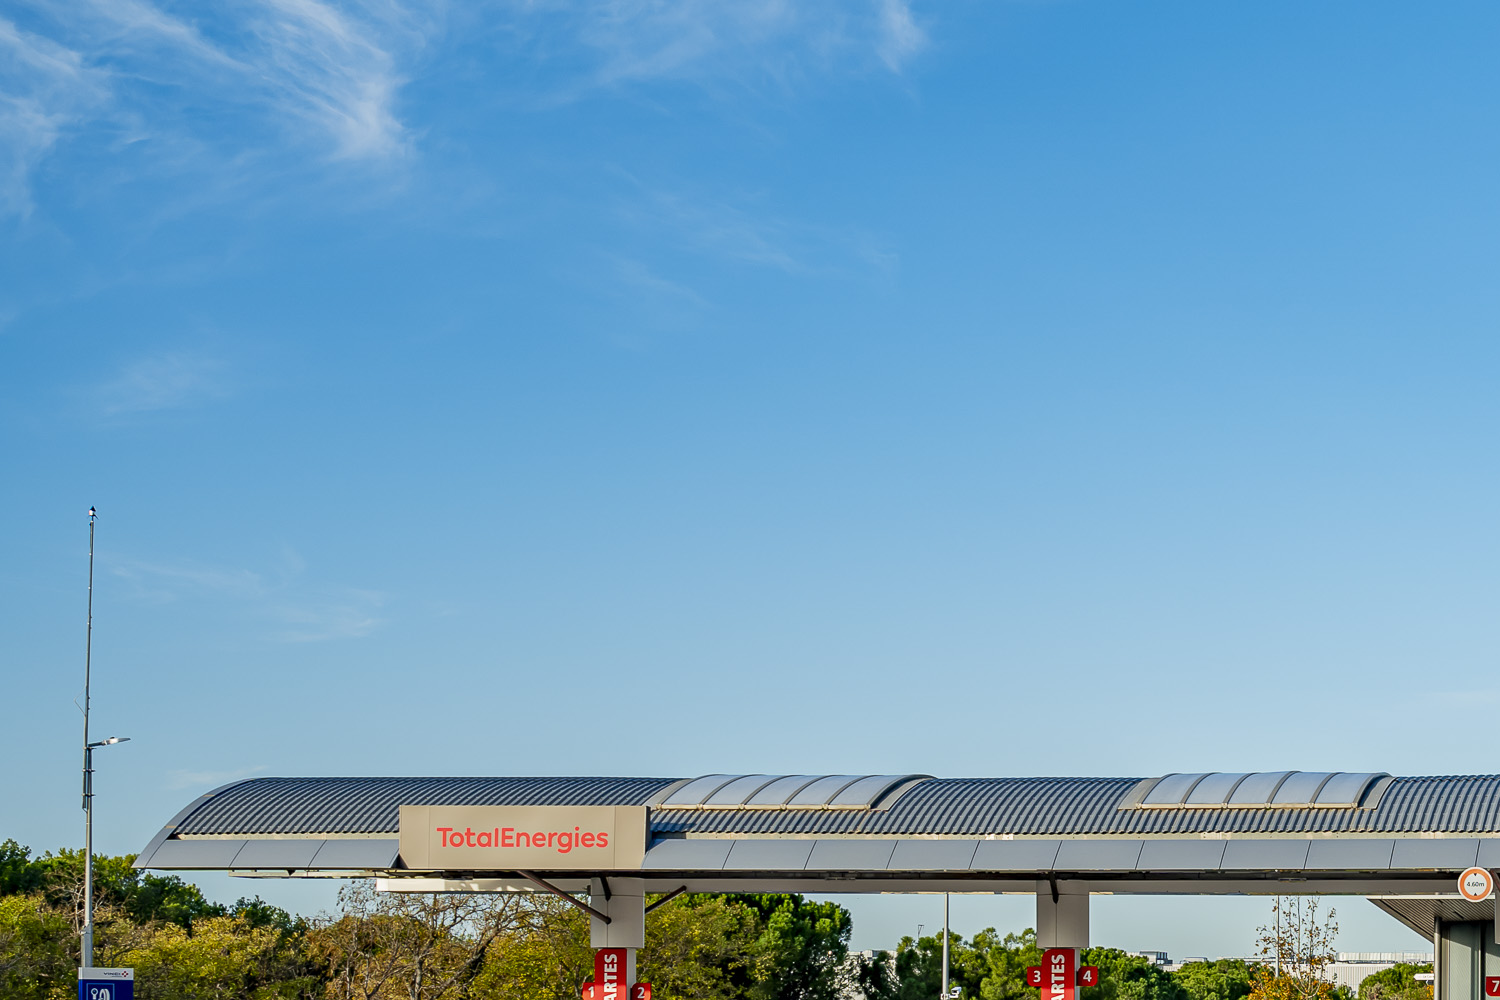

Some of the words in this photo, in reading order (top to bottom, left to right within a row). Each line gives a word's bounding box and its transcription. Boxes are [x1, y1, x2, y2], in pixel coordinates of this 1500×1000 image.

[436, 826, 608, 854] TotalEnergies
[1033, 970, 1041, 982] 3
[1083, 970, 1092, 982] 4
[587, 986, 594, 997] 1
[637, 986, 645, 999] 2
[1492, 980, 1500, 993] 7
